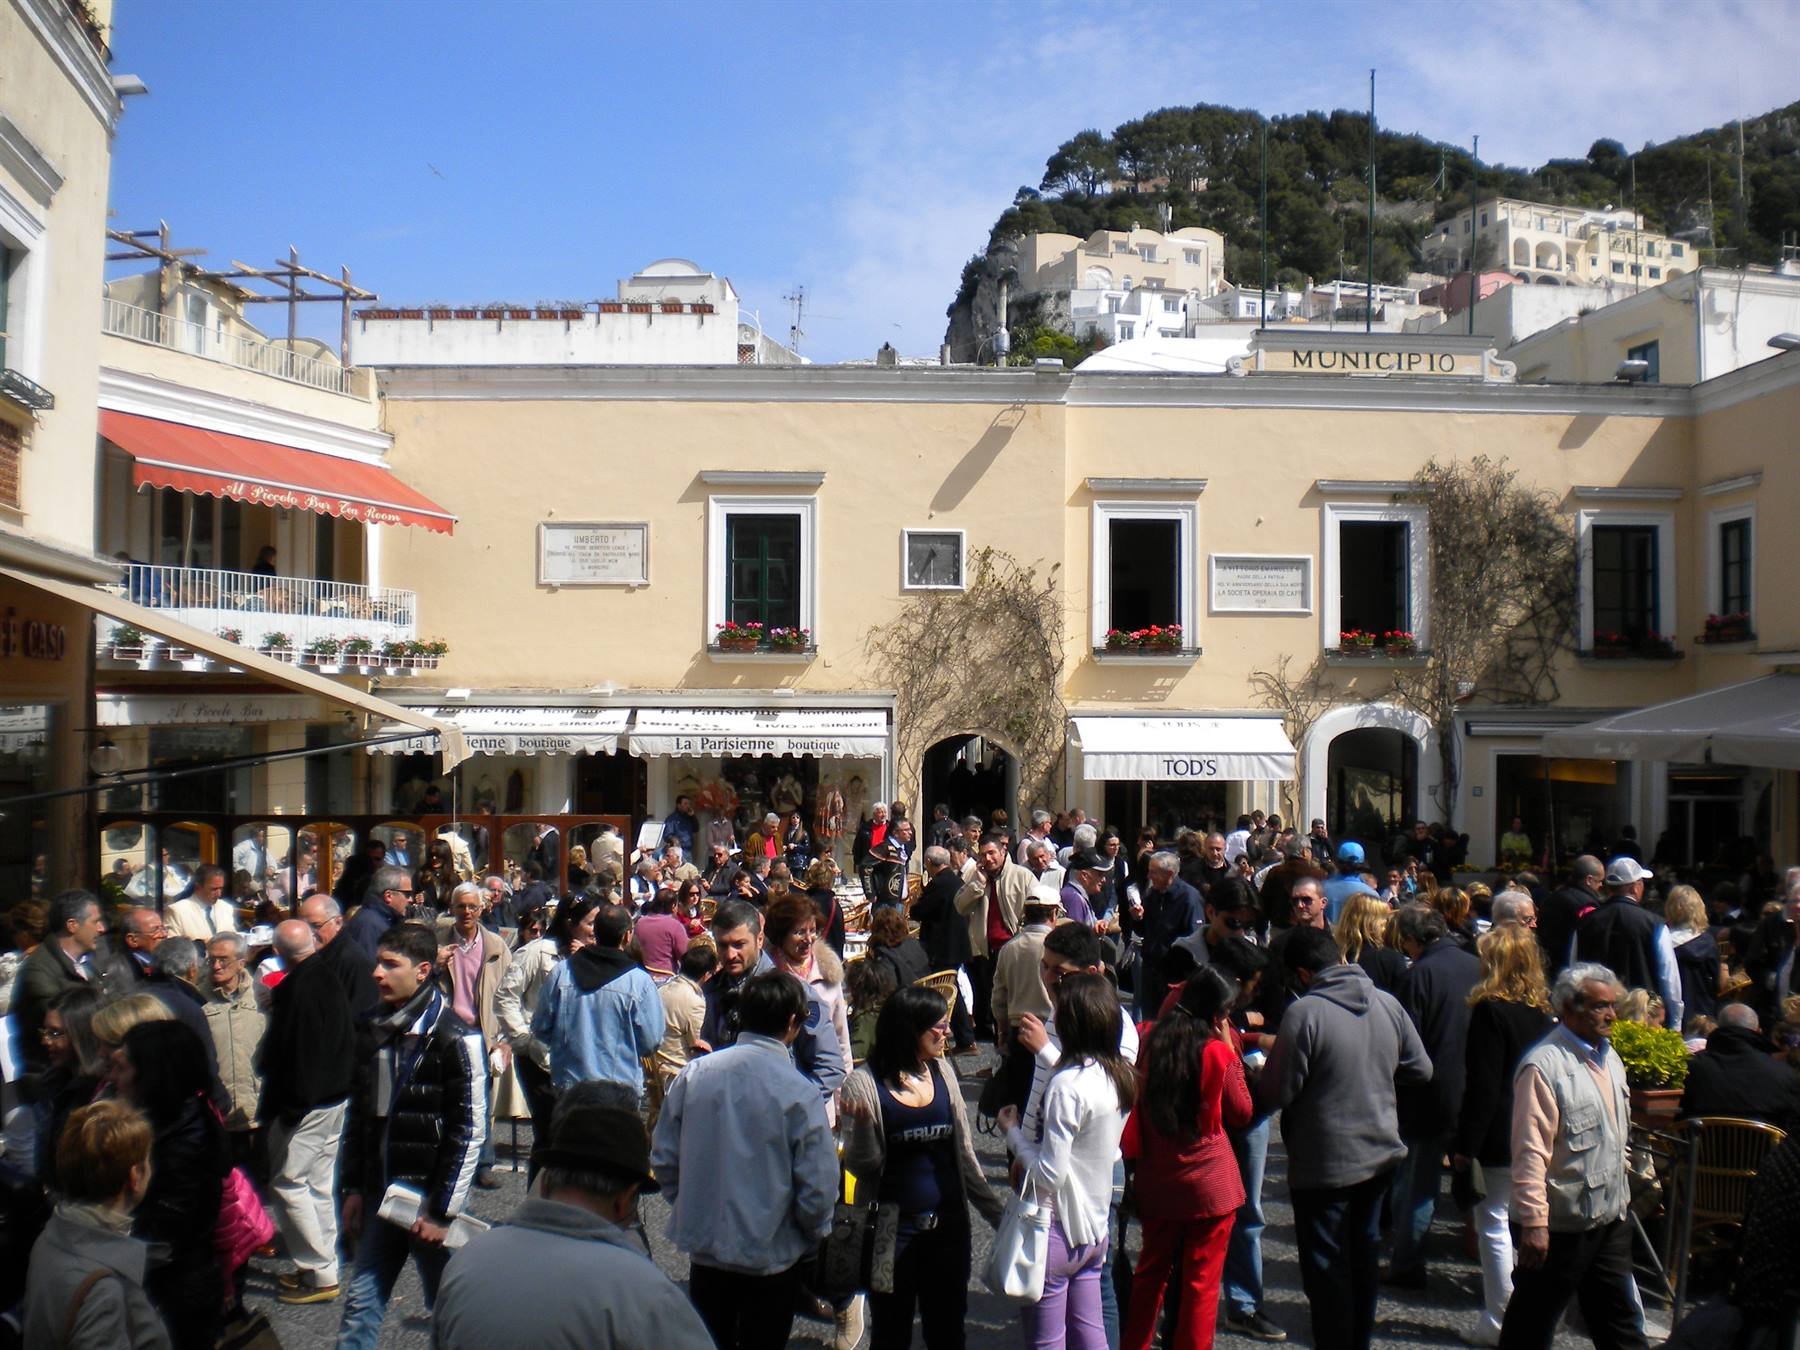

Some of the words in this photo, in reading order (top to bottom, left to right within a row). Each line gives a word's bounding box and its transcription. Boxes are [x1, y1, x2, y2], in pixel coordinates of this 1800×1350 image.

[1292, 350, 1455, 373] MUNICIPIO
[250, 485, 298, 505] Piccolo
[303, 495, 331, 510] Bar
[365, 506, 401, 522] Room
[574, 535, 609, 544] UMBERTO
[407, 735, 423, 749] La
[519, 737, 571, 750] boutique
[676, 737, 692, 750] La
[700, 737, 775, 750] Parisienne
[788, 738, 840, 752] boutique
[1162, 759, 1217, 776] TOD'S
